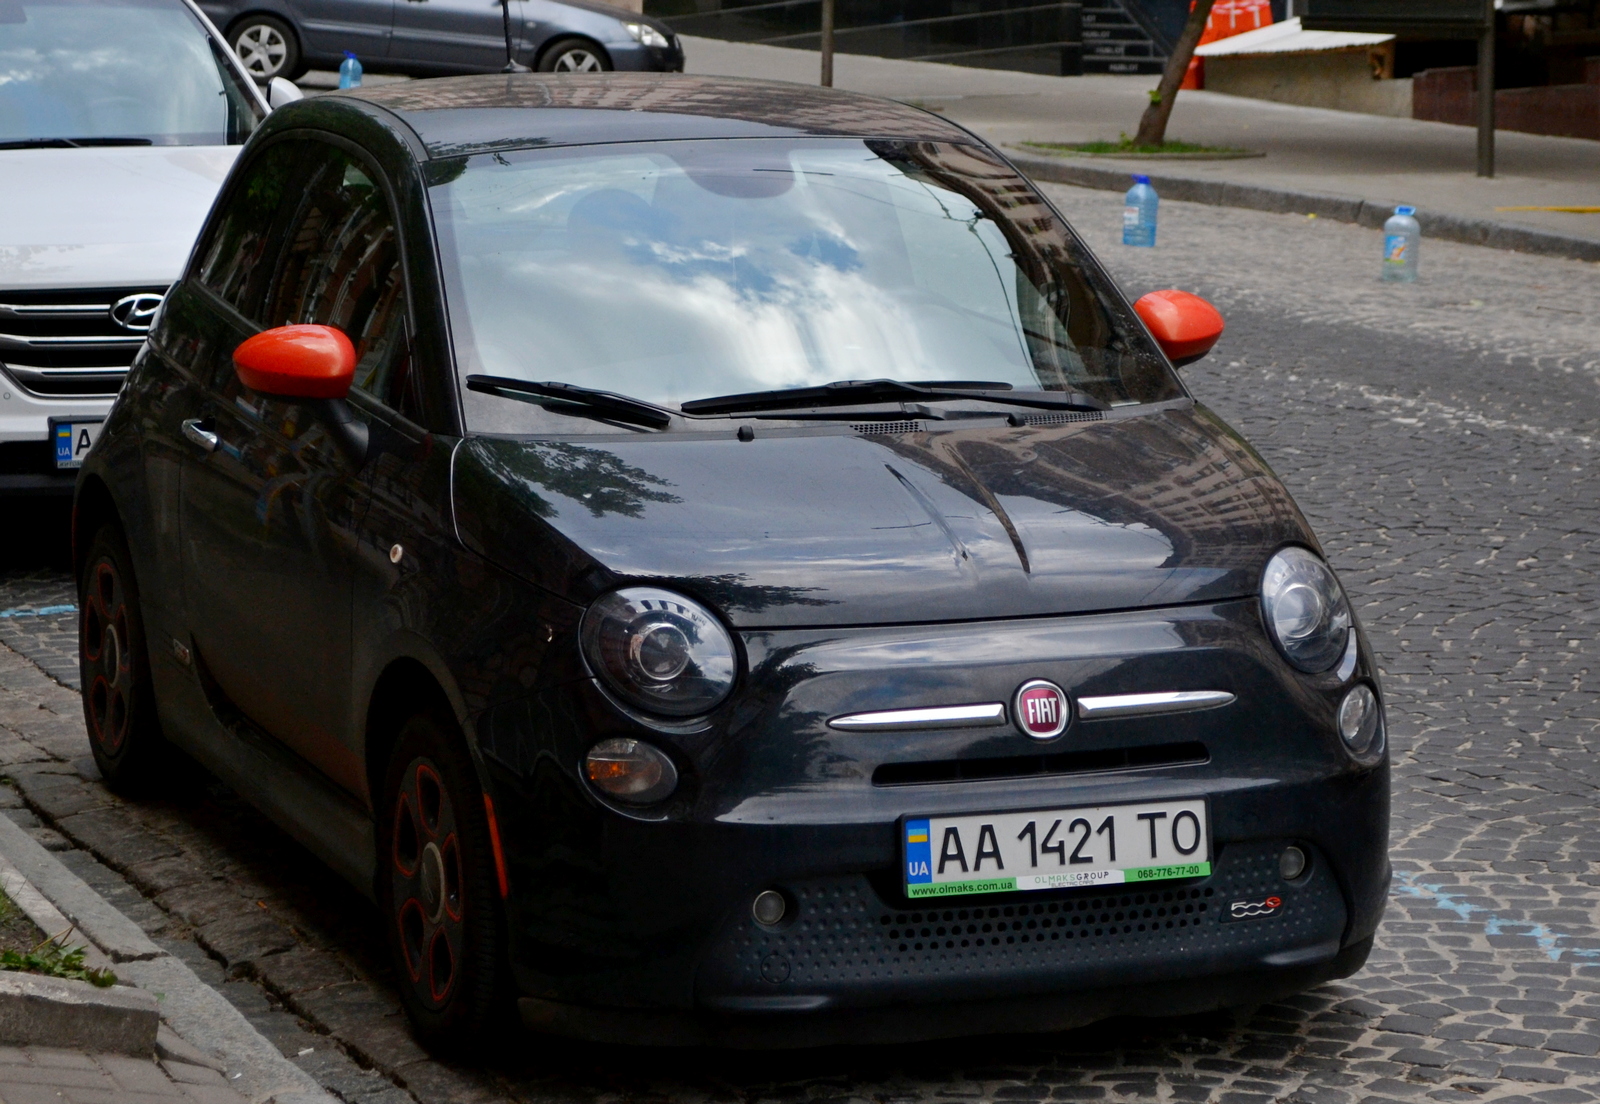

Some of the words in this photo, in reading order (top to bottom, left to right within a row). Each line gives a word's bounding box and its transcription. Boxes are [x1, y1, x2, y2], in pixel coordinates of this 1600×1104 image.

[58, 447, 70, 456] UA
[1027, 698, 1057, 724] FIAT
[937, 824, 1004, 874] AA
[1017, 815, 1116, 867] 1421
[1137, 810, 1201, 858] TO
[909, 861, 929, 876] UA
[1137, 865, 1199, 879] 068-776-77-00
[912, 881, 1013, 896] www.olmaks.com.ua
